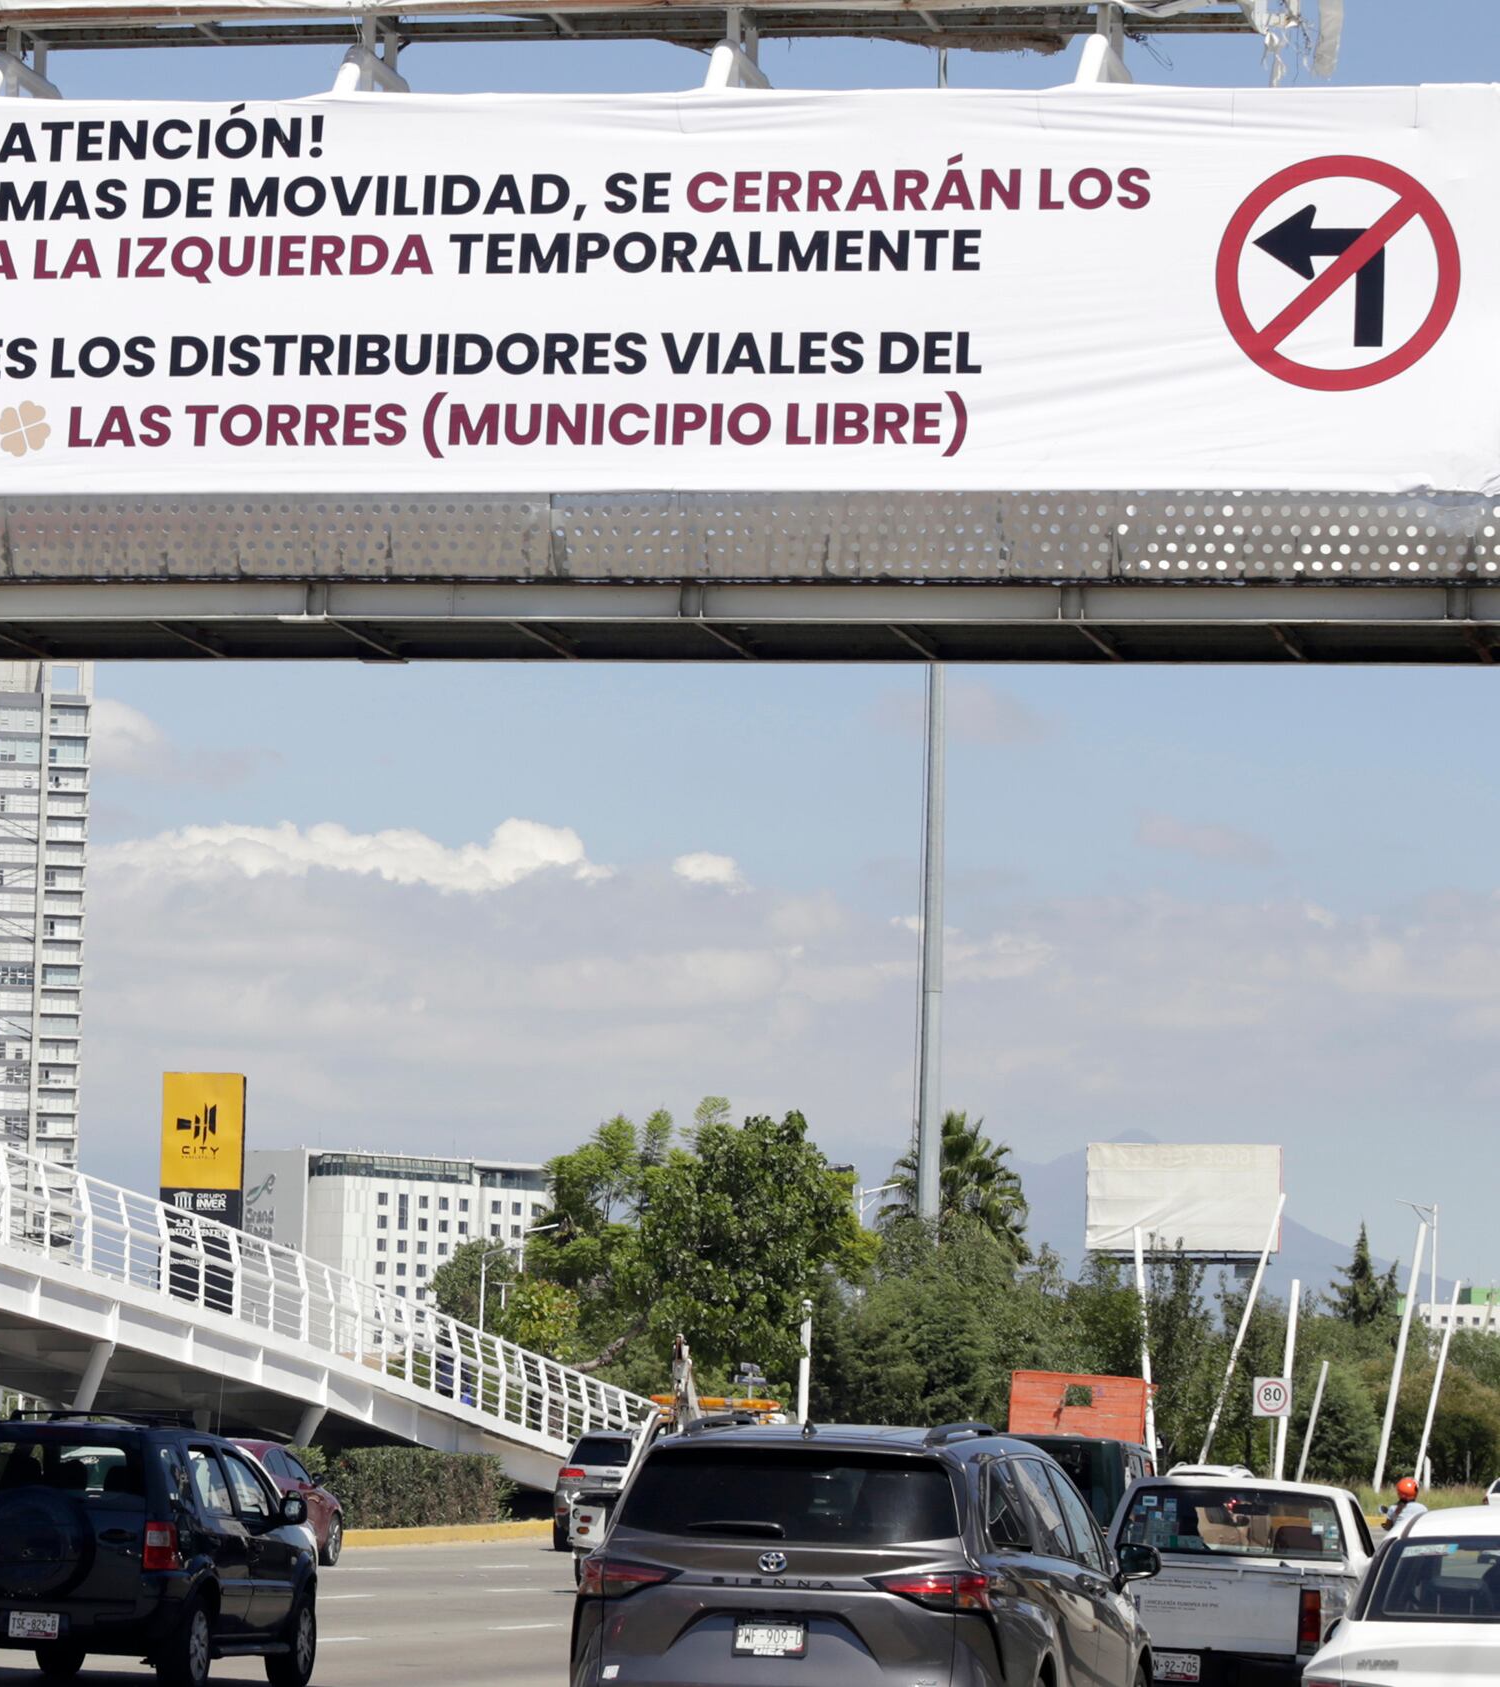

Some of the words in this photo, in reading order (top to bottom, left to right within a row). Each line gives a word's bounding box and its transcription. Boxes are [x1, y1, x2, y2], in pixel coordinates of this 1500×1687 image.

[143, 177, 214, 219] DE
[227, 173, 587, 220] MOVILIDAD,
[604, 172, 671, 214] SE
[686, 153, 1022, 213] CERRARÁN
[1038, 167, 1151, 211] LOS
[33, 238, 101, 280] LA
[117, 234, 434, 283] IZQUIERDA
[449, 229, 982, 274] TEMPORALMENTE
[50, 335, 156, 379] LOS
[168, 332, 648, 377] DISTRIBUIDORES
[661, 331, 865, 375] VIALES
[878, 331, 982, 374] DEL
[67, 404, 172, 448] LAS
[185, 402, 407, 447] TORRES
[422, 391, 772, 459] (MUNICIPIO
[785, 390, 968, 457] LIBRE)
[182, 1145, 219, 1155] CITY
[196, 1192, 227, 1200] GRUPO
[1264, 1388, 1281, 1401] 80
[712, 1576, 834, 1589] SIENNA
